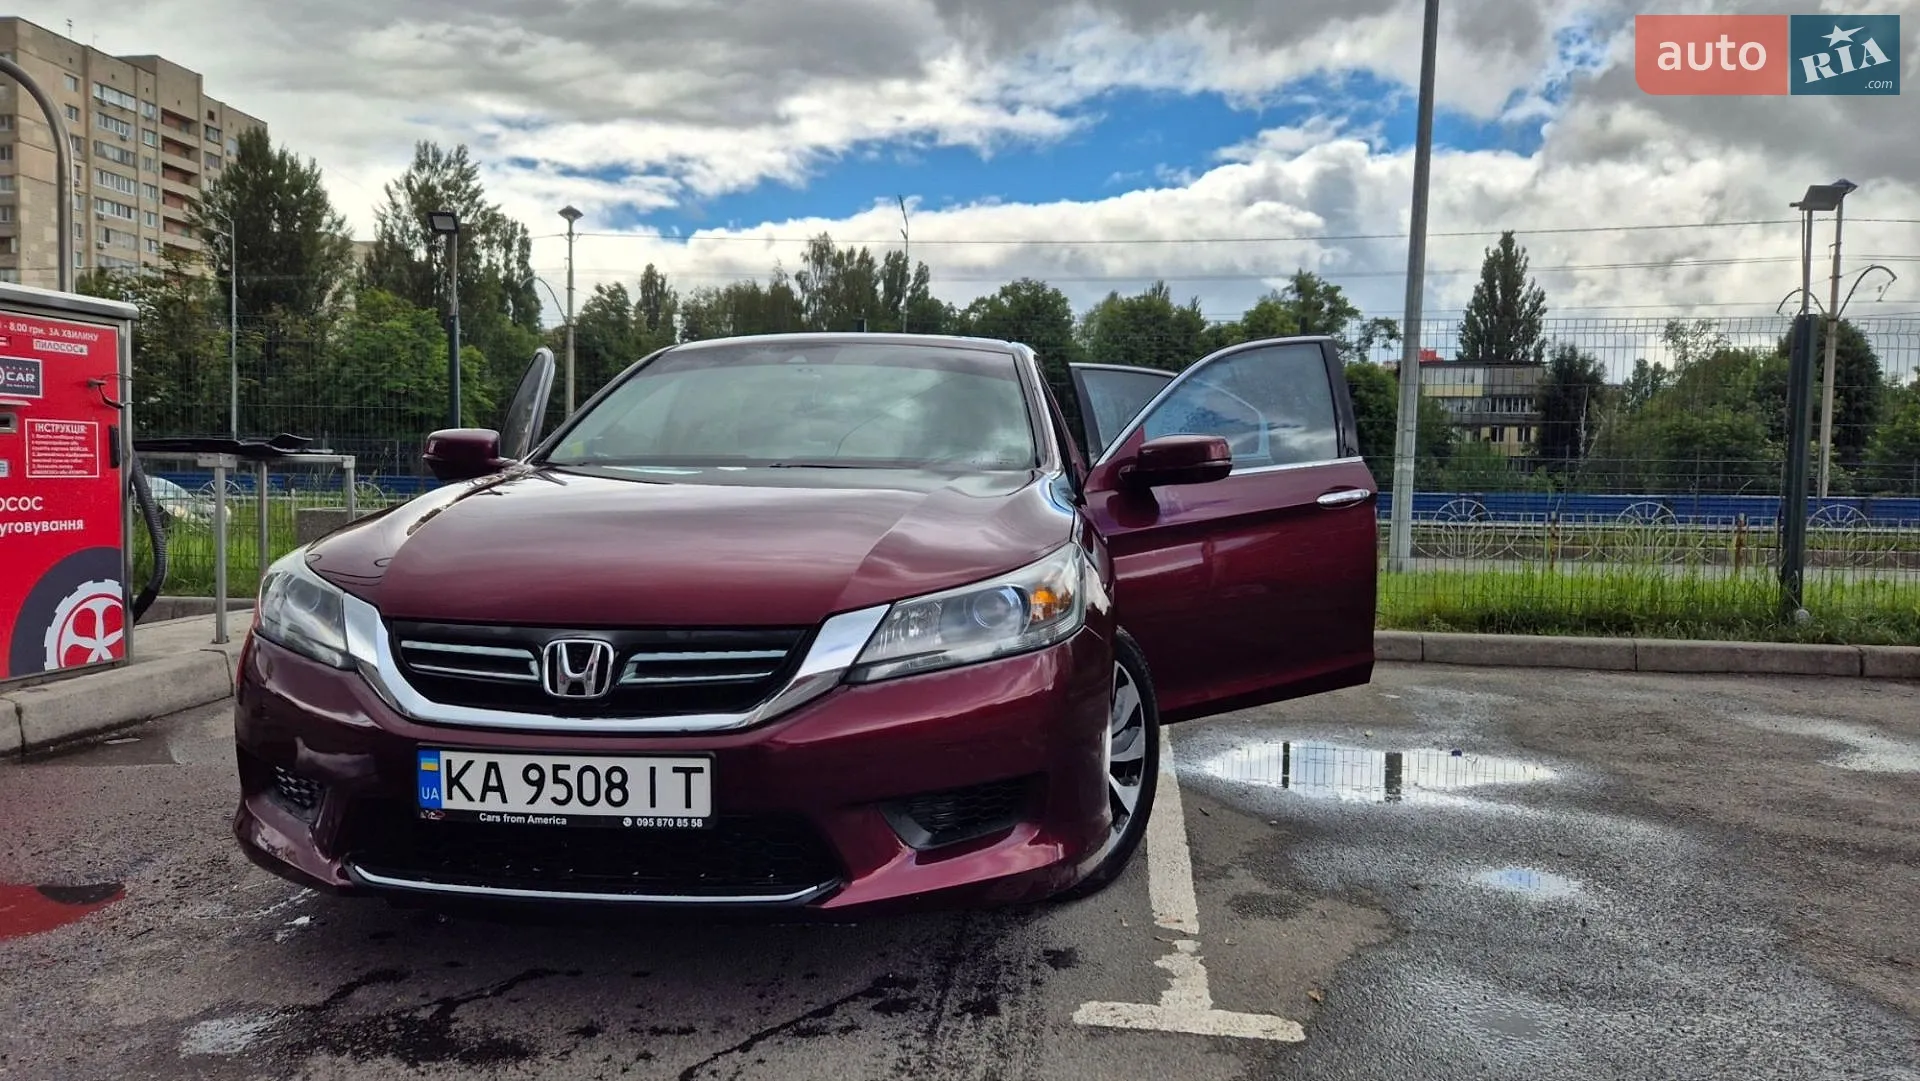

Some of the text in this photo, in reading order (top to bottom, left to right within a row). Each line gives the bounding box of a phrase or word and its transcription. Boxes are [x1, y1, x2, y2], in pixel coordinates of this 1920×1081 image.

[48, 327, 60, 337] ЗА
[6, 371, 36, 383] CAR
[445, 759, 508, 804] KA
[521, 763, 629, 807] 9508
[421, 786, 440, 801] UA
[479, 812, 567, 826] Cars from America
[636, 818, 703, 828] 095 870 85 58
